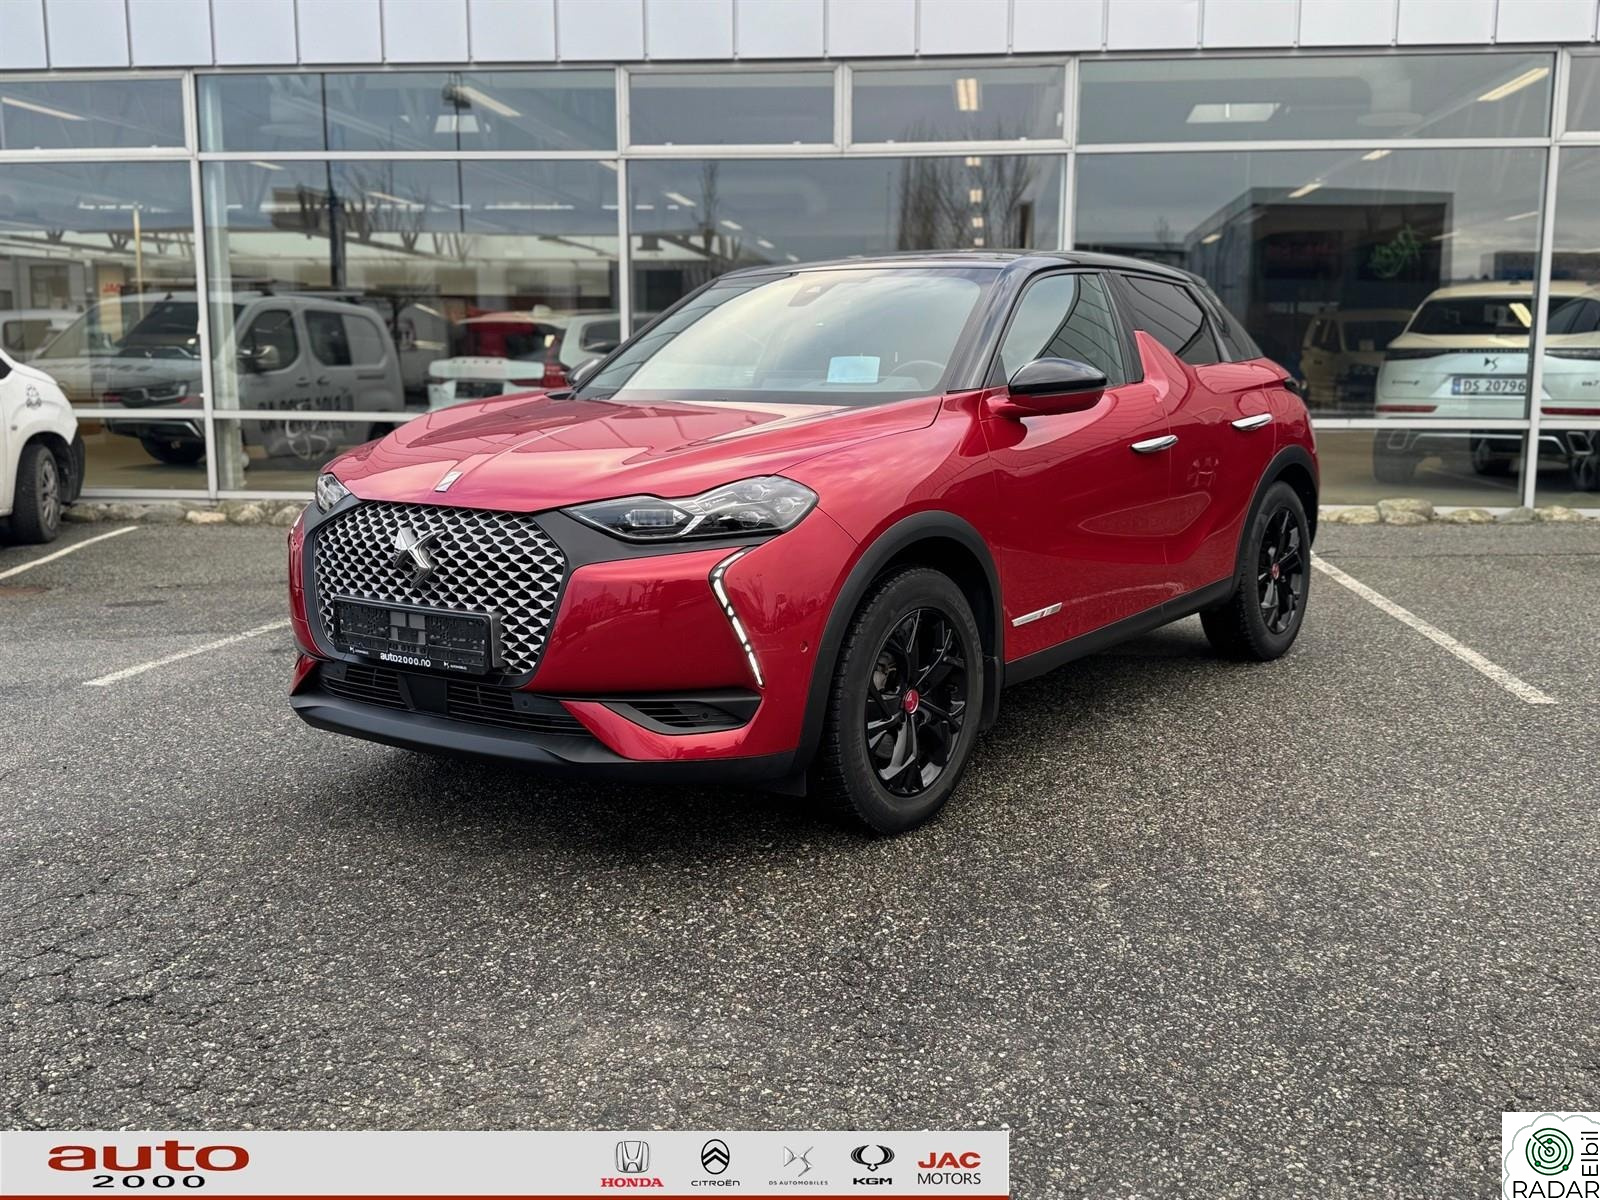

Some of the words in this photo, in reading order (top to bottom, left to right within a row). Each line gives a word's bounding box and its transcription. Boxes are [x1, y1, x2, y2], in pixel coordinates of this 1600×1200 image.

[1463, 380, 1480, 391] DS
[1485, 380, 1526, 391] 20796
[380, 652, 432, 668] auto2000.no
